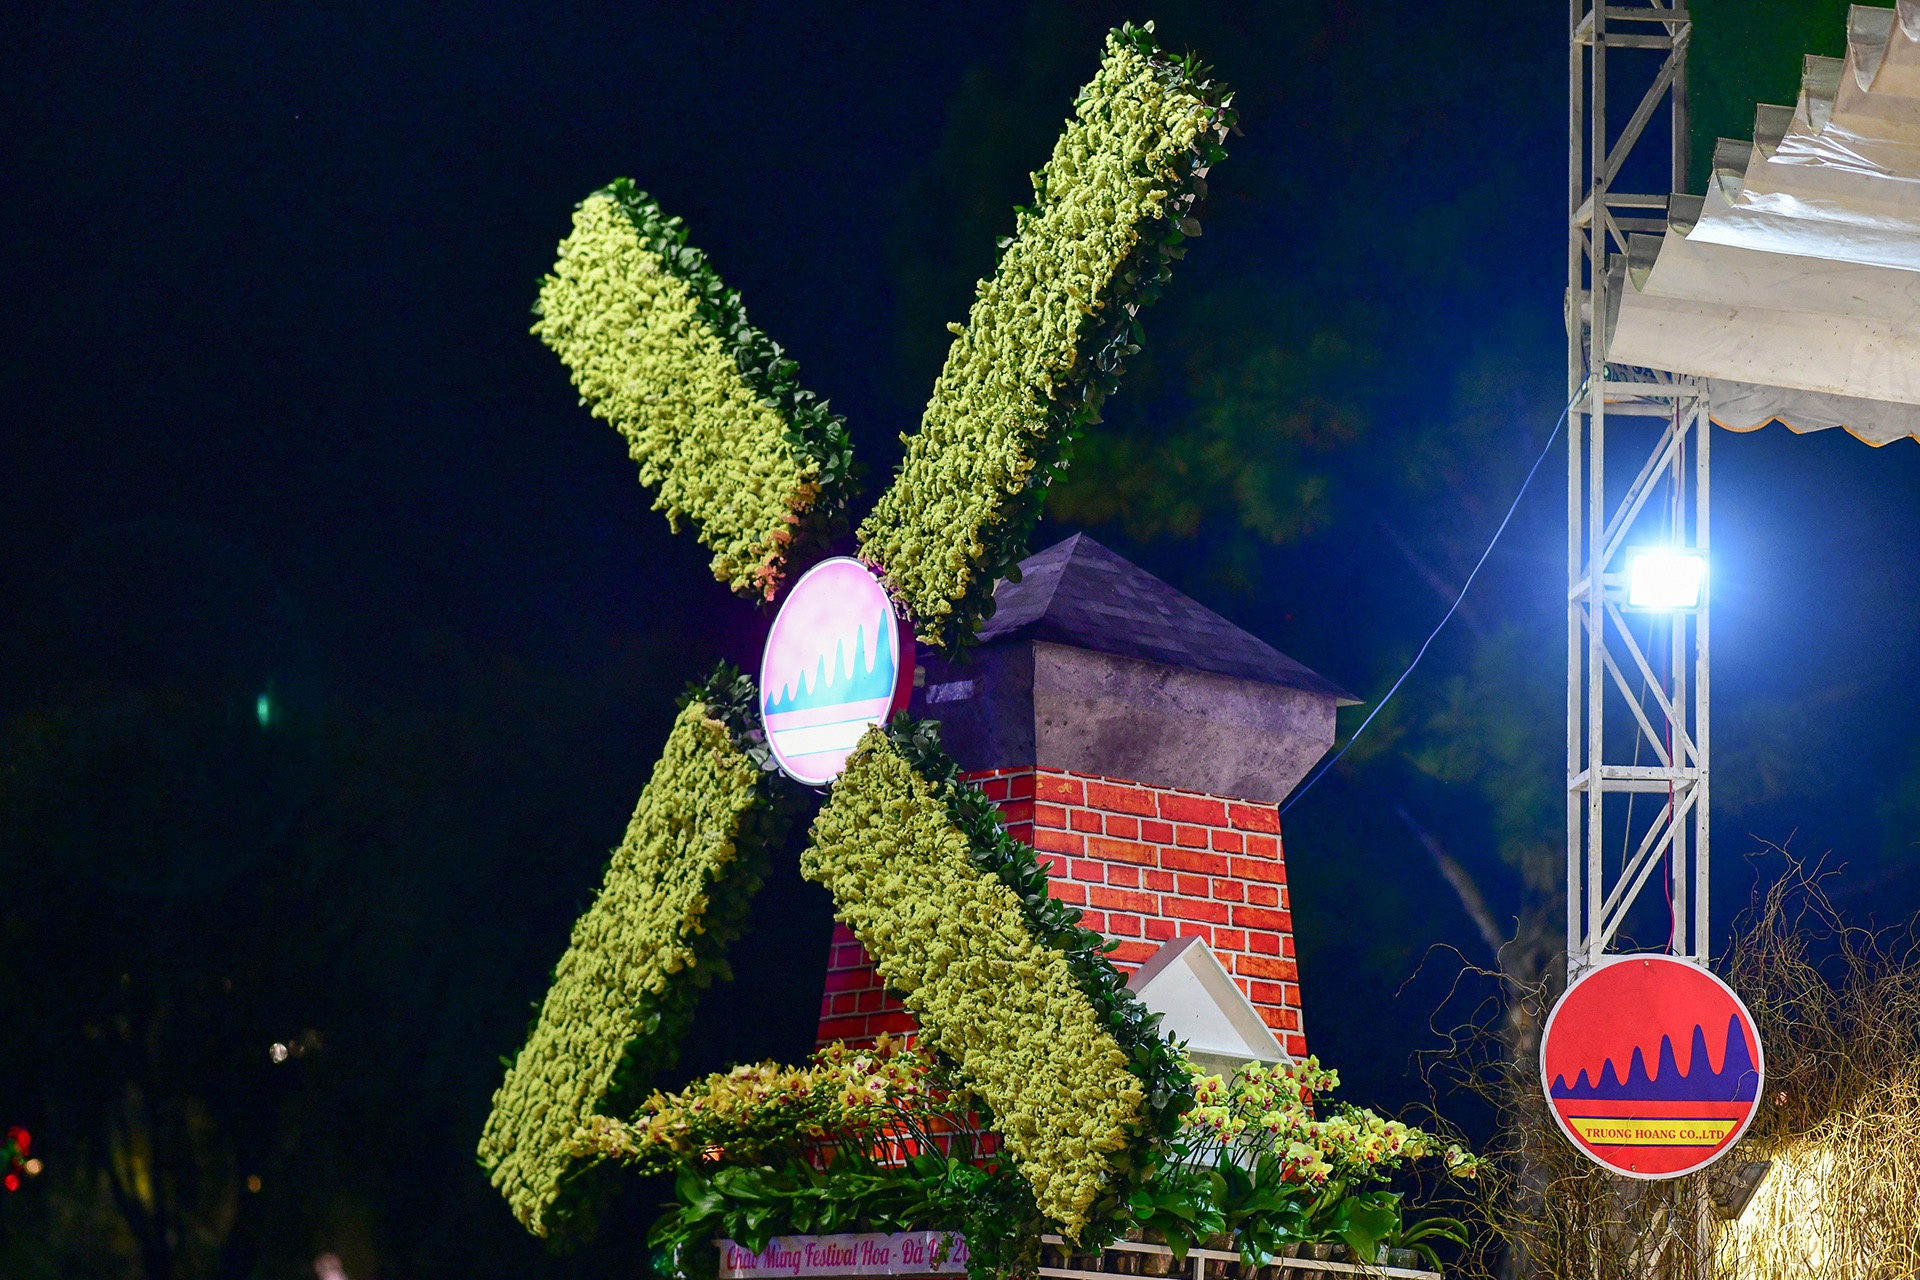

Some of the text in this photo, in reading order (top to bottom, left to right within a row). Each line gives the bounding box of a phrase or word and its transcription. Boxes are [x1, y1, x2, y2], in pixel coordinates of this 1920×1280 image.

[1585, 1128, 1725, 1140] TRUONG HOANG CO.,LTD
[805, 1242, 859, 1267] Festival
[861, 1240, 890, 1266] Hoa
[902, 1238, 924, 1265] Đà
